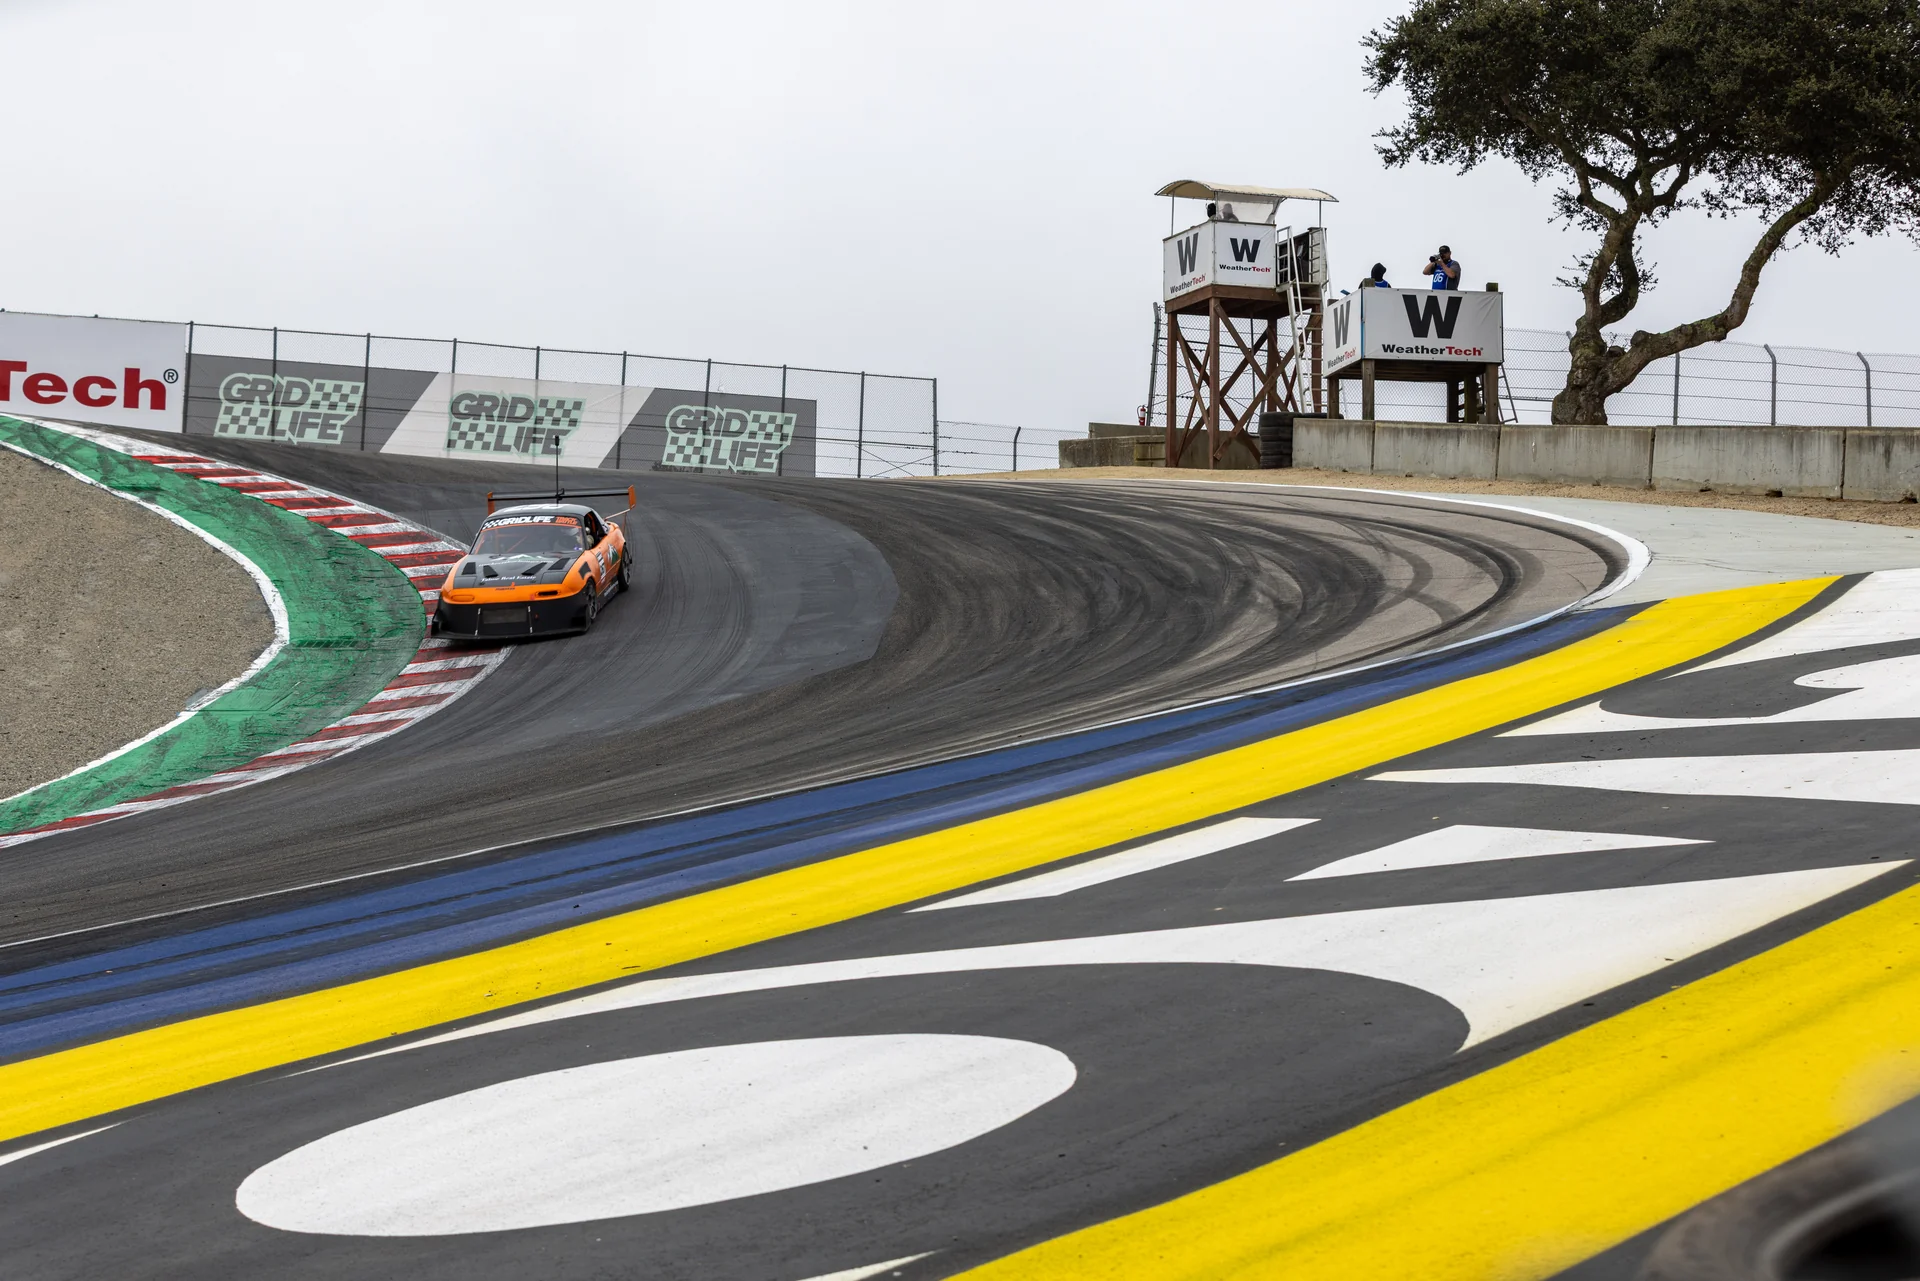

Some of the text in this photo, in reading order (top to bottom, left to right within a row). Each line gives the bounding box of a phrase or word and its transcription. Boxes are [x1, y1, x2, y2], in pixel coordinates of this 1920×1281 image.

[1177, 232, 1199, 276] W
[1230, 238, 1261, 263] W
[1219, 264, 1271, 273] WeatherTech
[1333, 299, 1351, 349] W
[1402, 294, 1463, 339] W
[222, 376, 311, 407] GRID
[450, 392, 535, 423] GRID
[275, 408, 346, 441] LIFE
[668, 409, 749, 438] GRID
[492, 424, 571, 456] LIFE
[710, 440, 785, 470] LIFE
